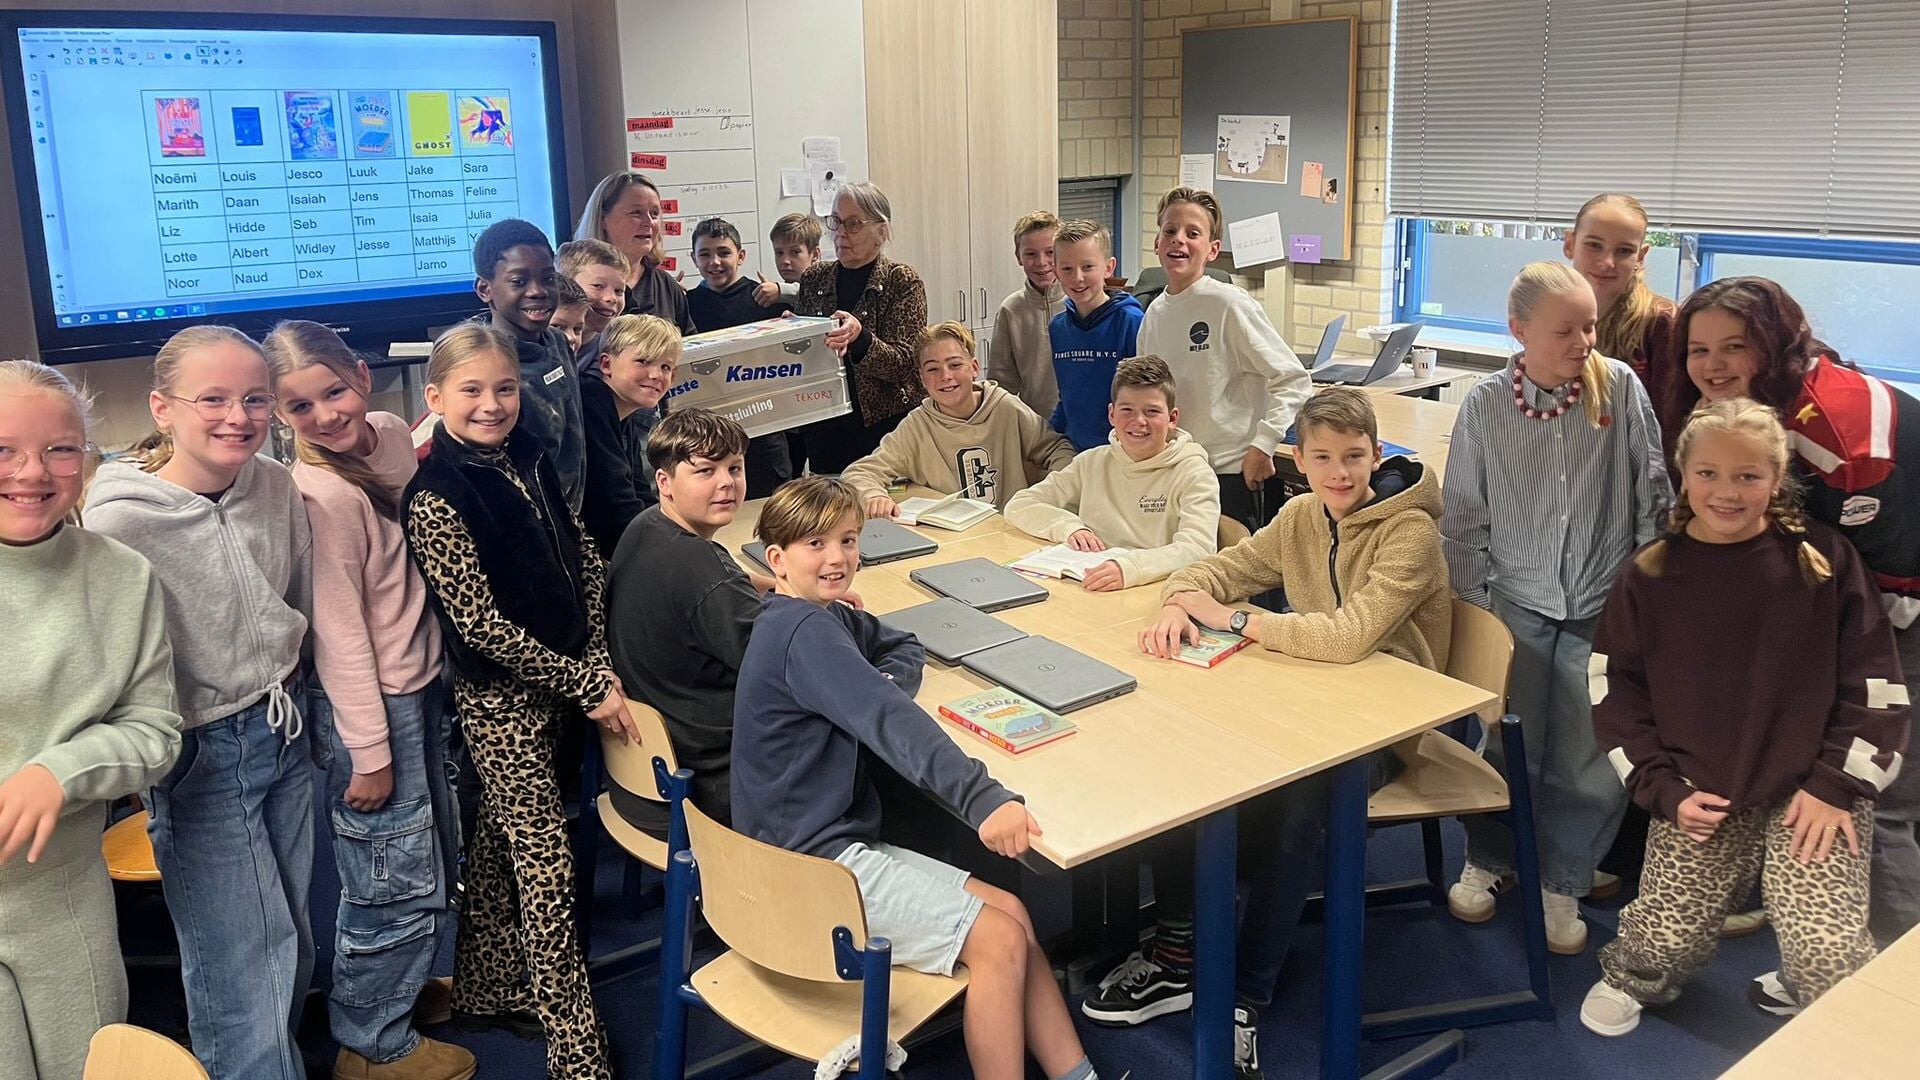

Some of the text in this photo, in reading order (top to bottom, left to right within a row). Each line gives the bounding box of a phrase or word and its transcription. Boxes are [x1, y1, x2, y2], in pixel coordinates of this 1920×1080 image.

[354, 103, 390, 117] MOEDER
[632, 120, 670, 130] maandag
[415, 142, 451, 150] GHOST
[632, 155, 665, 167] dinsdag
[349, 166, 378, 178] Luuk
[408, 165, 434, 175] Jake
[463, 163, 489, 174] Sara
[154, 172, 197, 185] Noëmi
[222, 171, 257, 182] Louis
[287, 169, 323, 180] Jesco
[352, 191, 379, 202] Jens
[410, 188, 454, 199] Thomas
[465, 186, 497, 197] Feline
[225, 197, 260, 208] Daan
[290, 193, 327, 205] Isaiah
[158, 199, 199, 211] Marith
[354, 215, 376, 226] Tim
[412, 212, 438, 223] Isaia
[467, 209, 492, 221] Julia
[229, 222, 266, 233] Hidde
[293, 219, 318, 230] Seb
[161, 226, 182, 237] Liz
[357, 240, 390, 251] Jesse
[415, 235, 457, 247] Matthijs
[232, 247, 269, 260] Albert
[295, 243, 336, 255] Widley
[164, 252, 197, 264] Lotte
[417, 260, 448, 271] Jarno
[235, 272, 269, 284] Naud
[299, 269, 323, 280] Dex
[168, 277, 200, 289] Noor
[726, 363, 802, 383] Kansen
[664, 380, 699, 400] rste
[795, 390, 833, 402] TEKORT
[724, 399, 774, 421] itsluiting
[966, 698, 1021, 716] MOEDER
